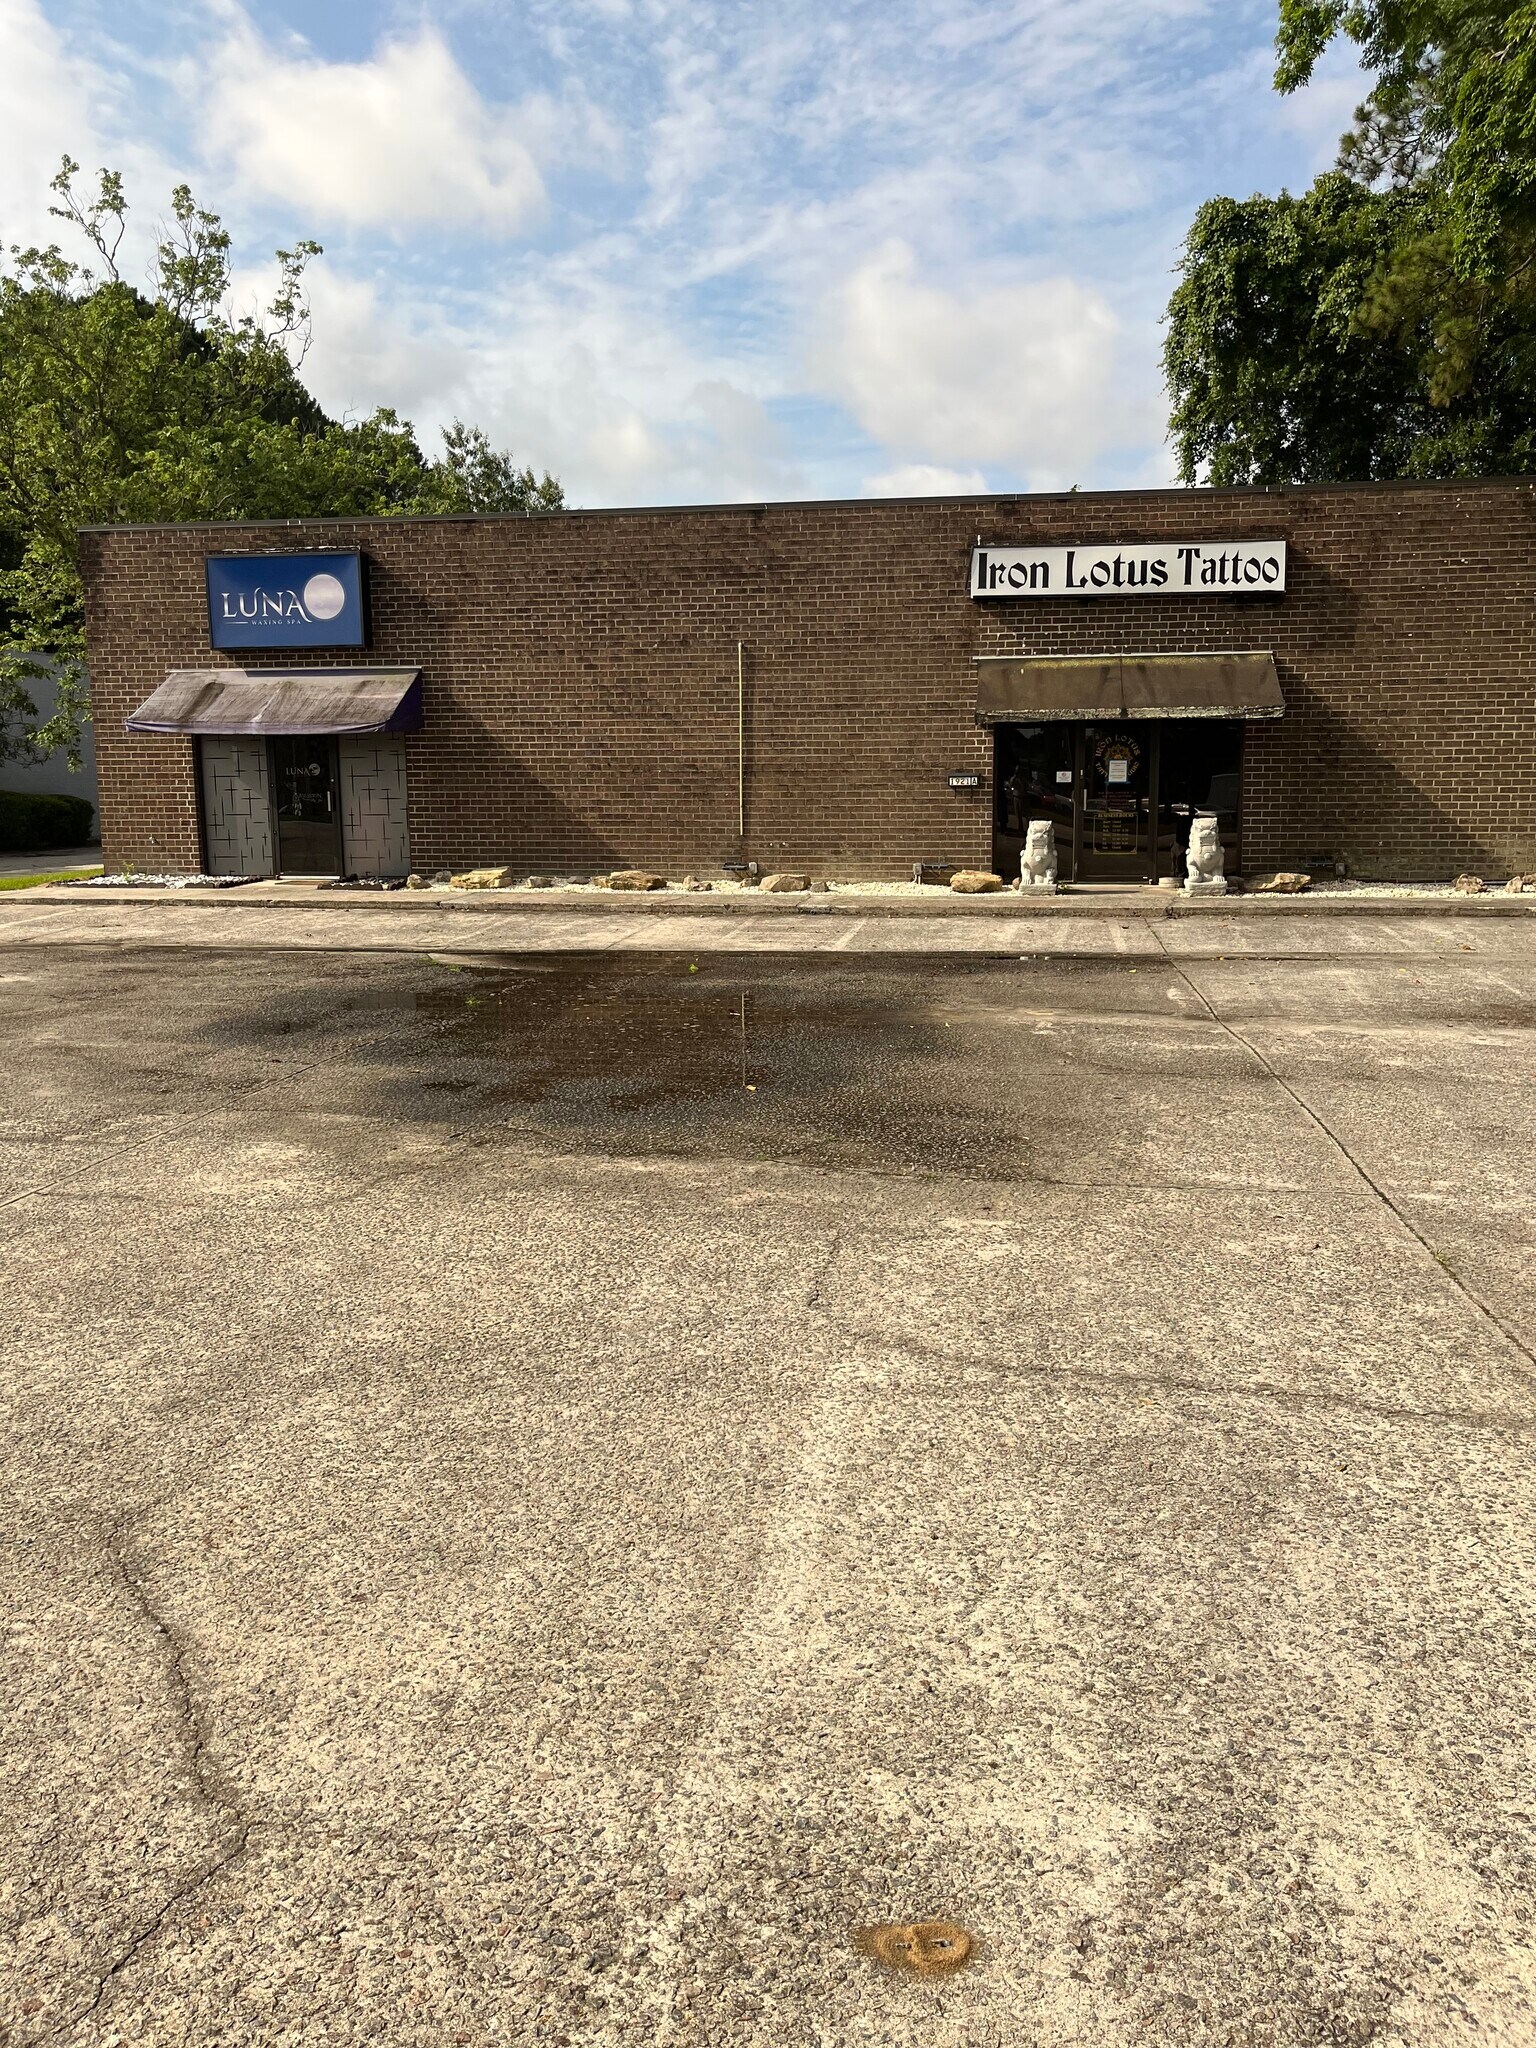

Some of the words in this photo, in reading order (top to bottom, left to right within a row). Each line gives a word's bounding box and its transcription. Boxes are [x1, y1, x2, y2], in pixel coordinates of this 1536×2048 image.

[977, 552, 1049, 590] Iron
[1065, 550, 1169, 589] Lotus
[1177, 547, 1280, 586] Tattoo
[221, 586, 312, 622] LUNA
[1115, 734, 1141, 756] LOTUS
[286, 767, 311, 776] LUNA
